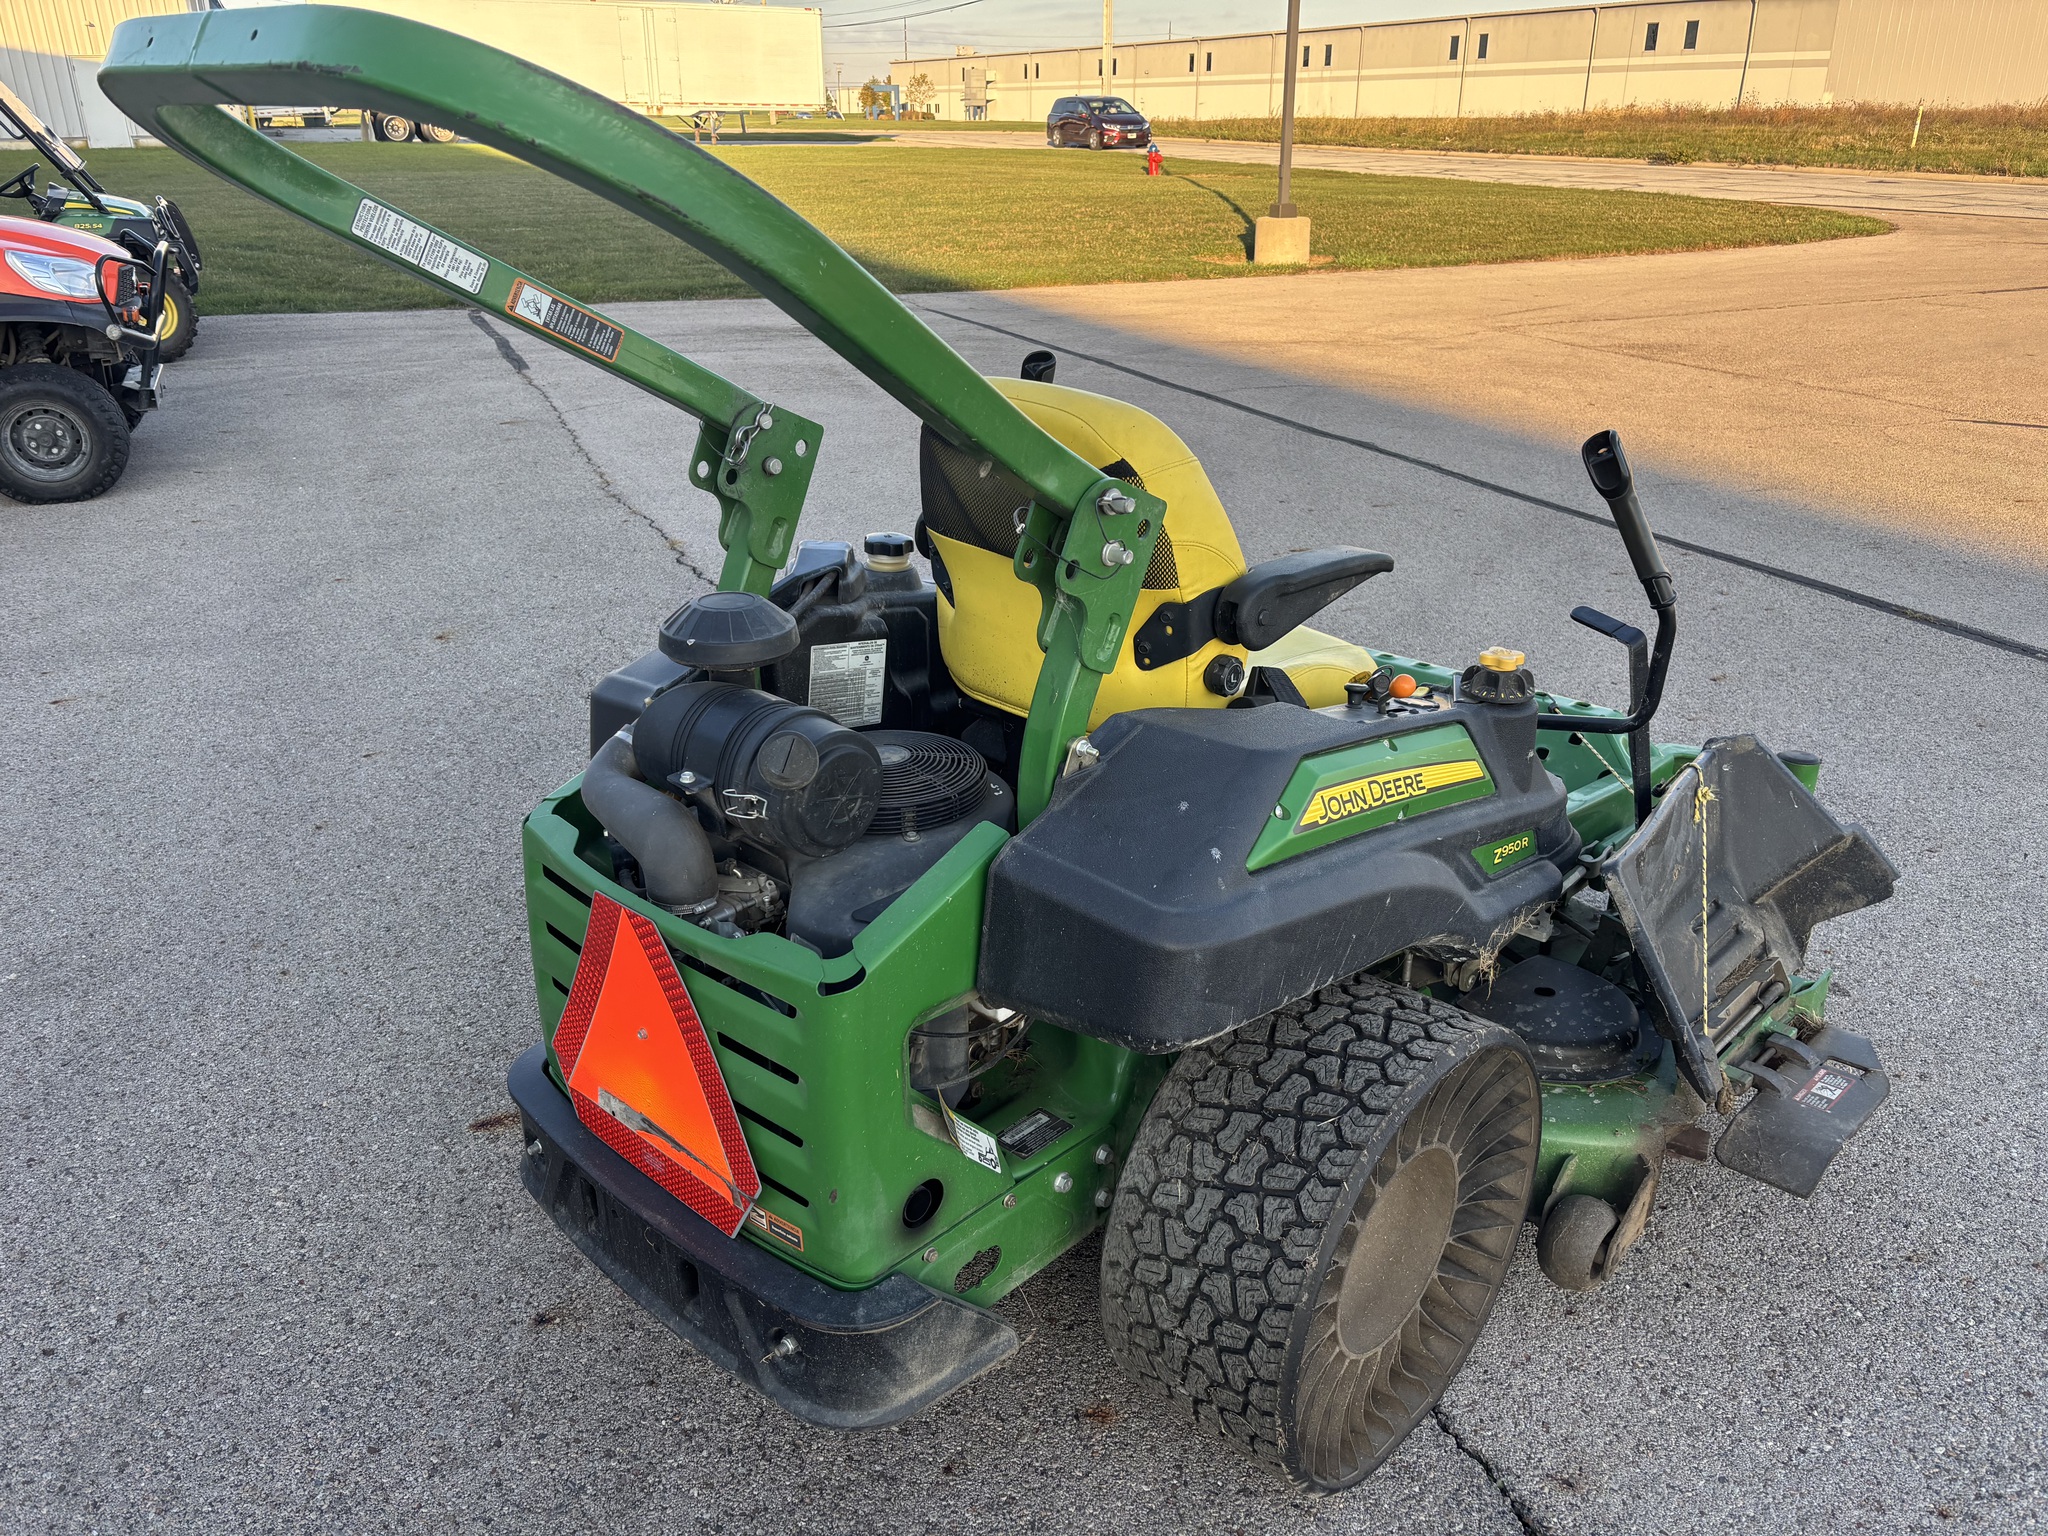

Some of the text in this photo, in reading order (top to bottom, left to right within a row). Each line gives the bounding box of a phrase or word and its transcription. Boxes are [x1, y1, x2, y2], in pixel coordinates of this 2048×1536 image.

[1320, 772, 1426, 820] JOHN DEERE
[1494, 836, 1529, 864] Z950R
